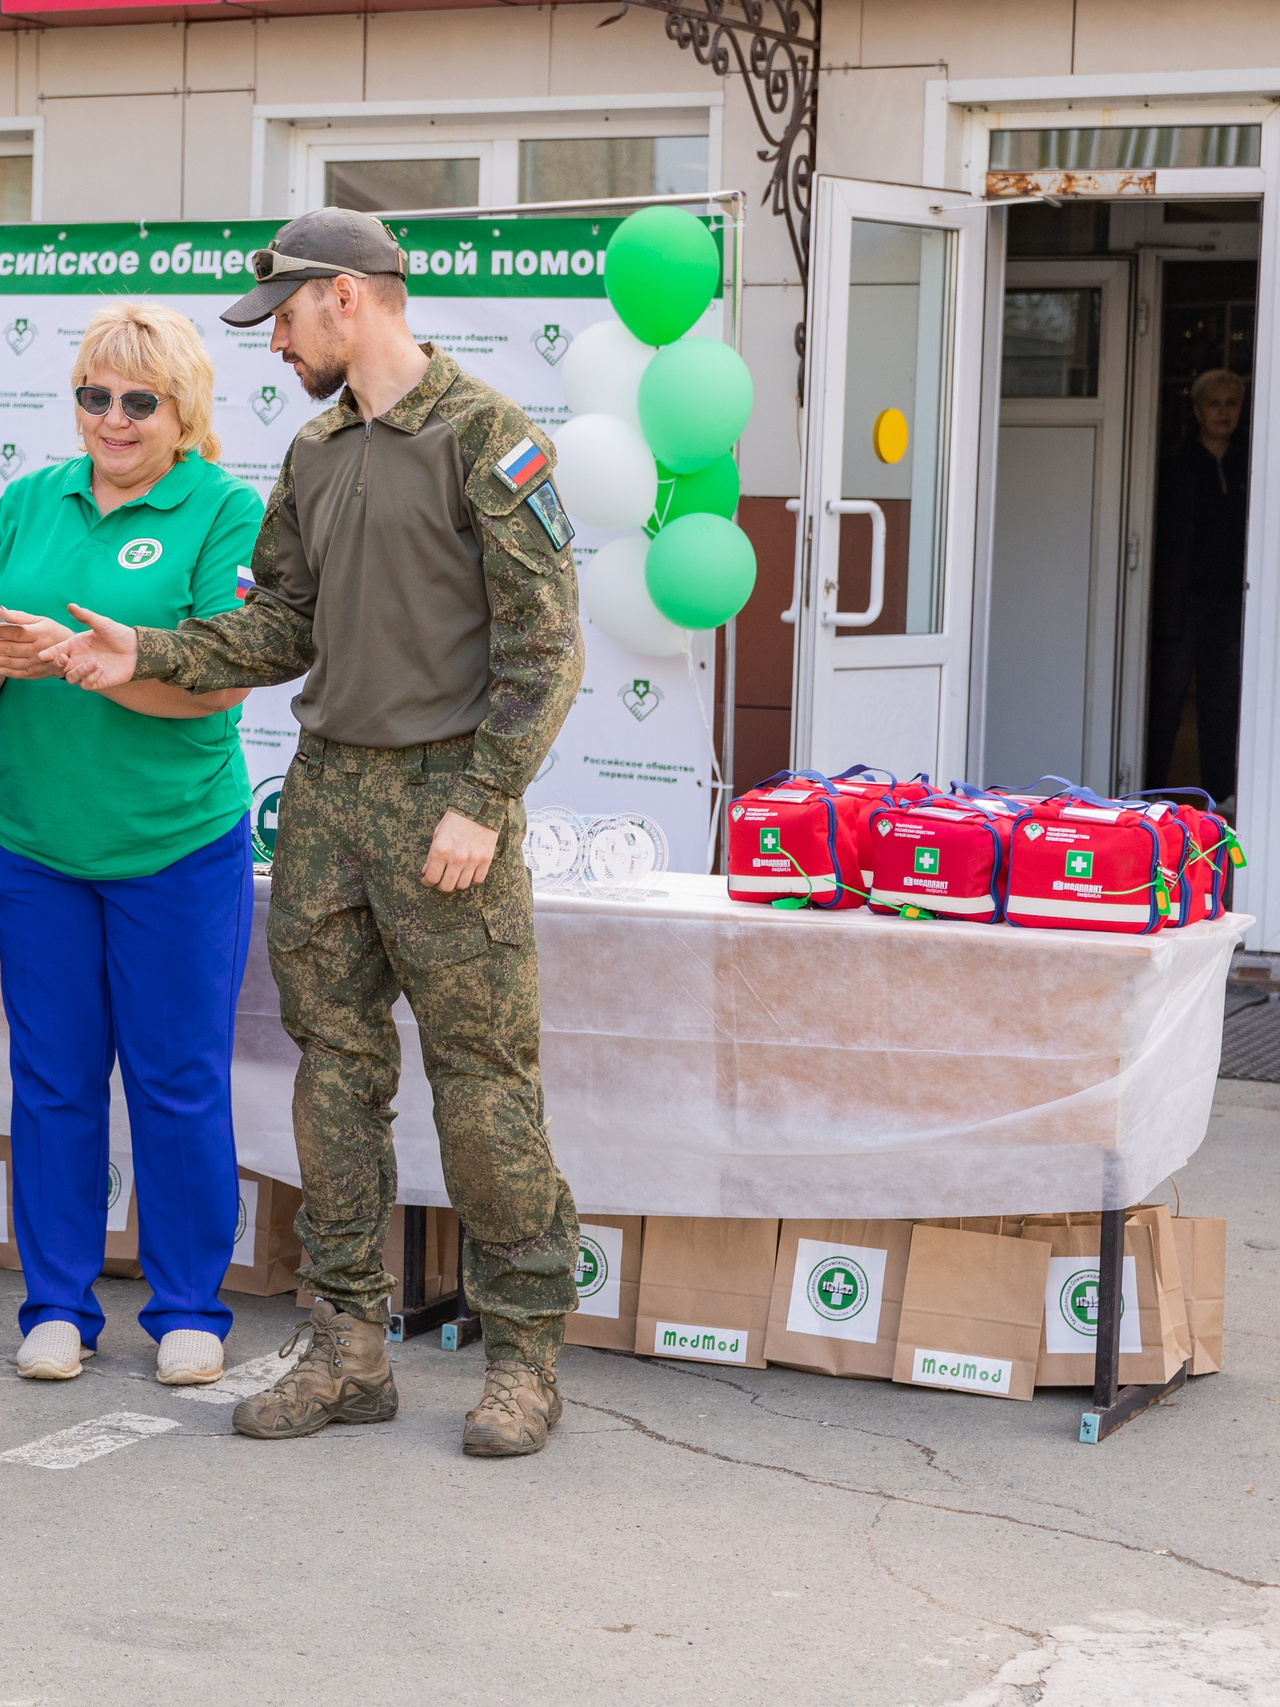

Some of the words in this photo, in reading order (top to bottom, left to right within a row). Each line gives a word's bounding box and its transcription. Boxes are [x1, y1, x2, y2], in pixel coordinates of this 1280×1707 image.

[408, 241, 477, 276] вой
[491, 250, 606, 276] помо
[465, 333, 509, 342] общество
[583, 756, 643, 769] Российское
[645, 761, 696, 774] общество
[599, 769, 635, 782] первой
[636, 774, 679, 785] помощи
[663, 1330, 740, 1353] MedMod
[922, 1357, 1003, 1384] MedMod
